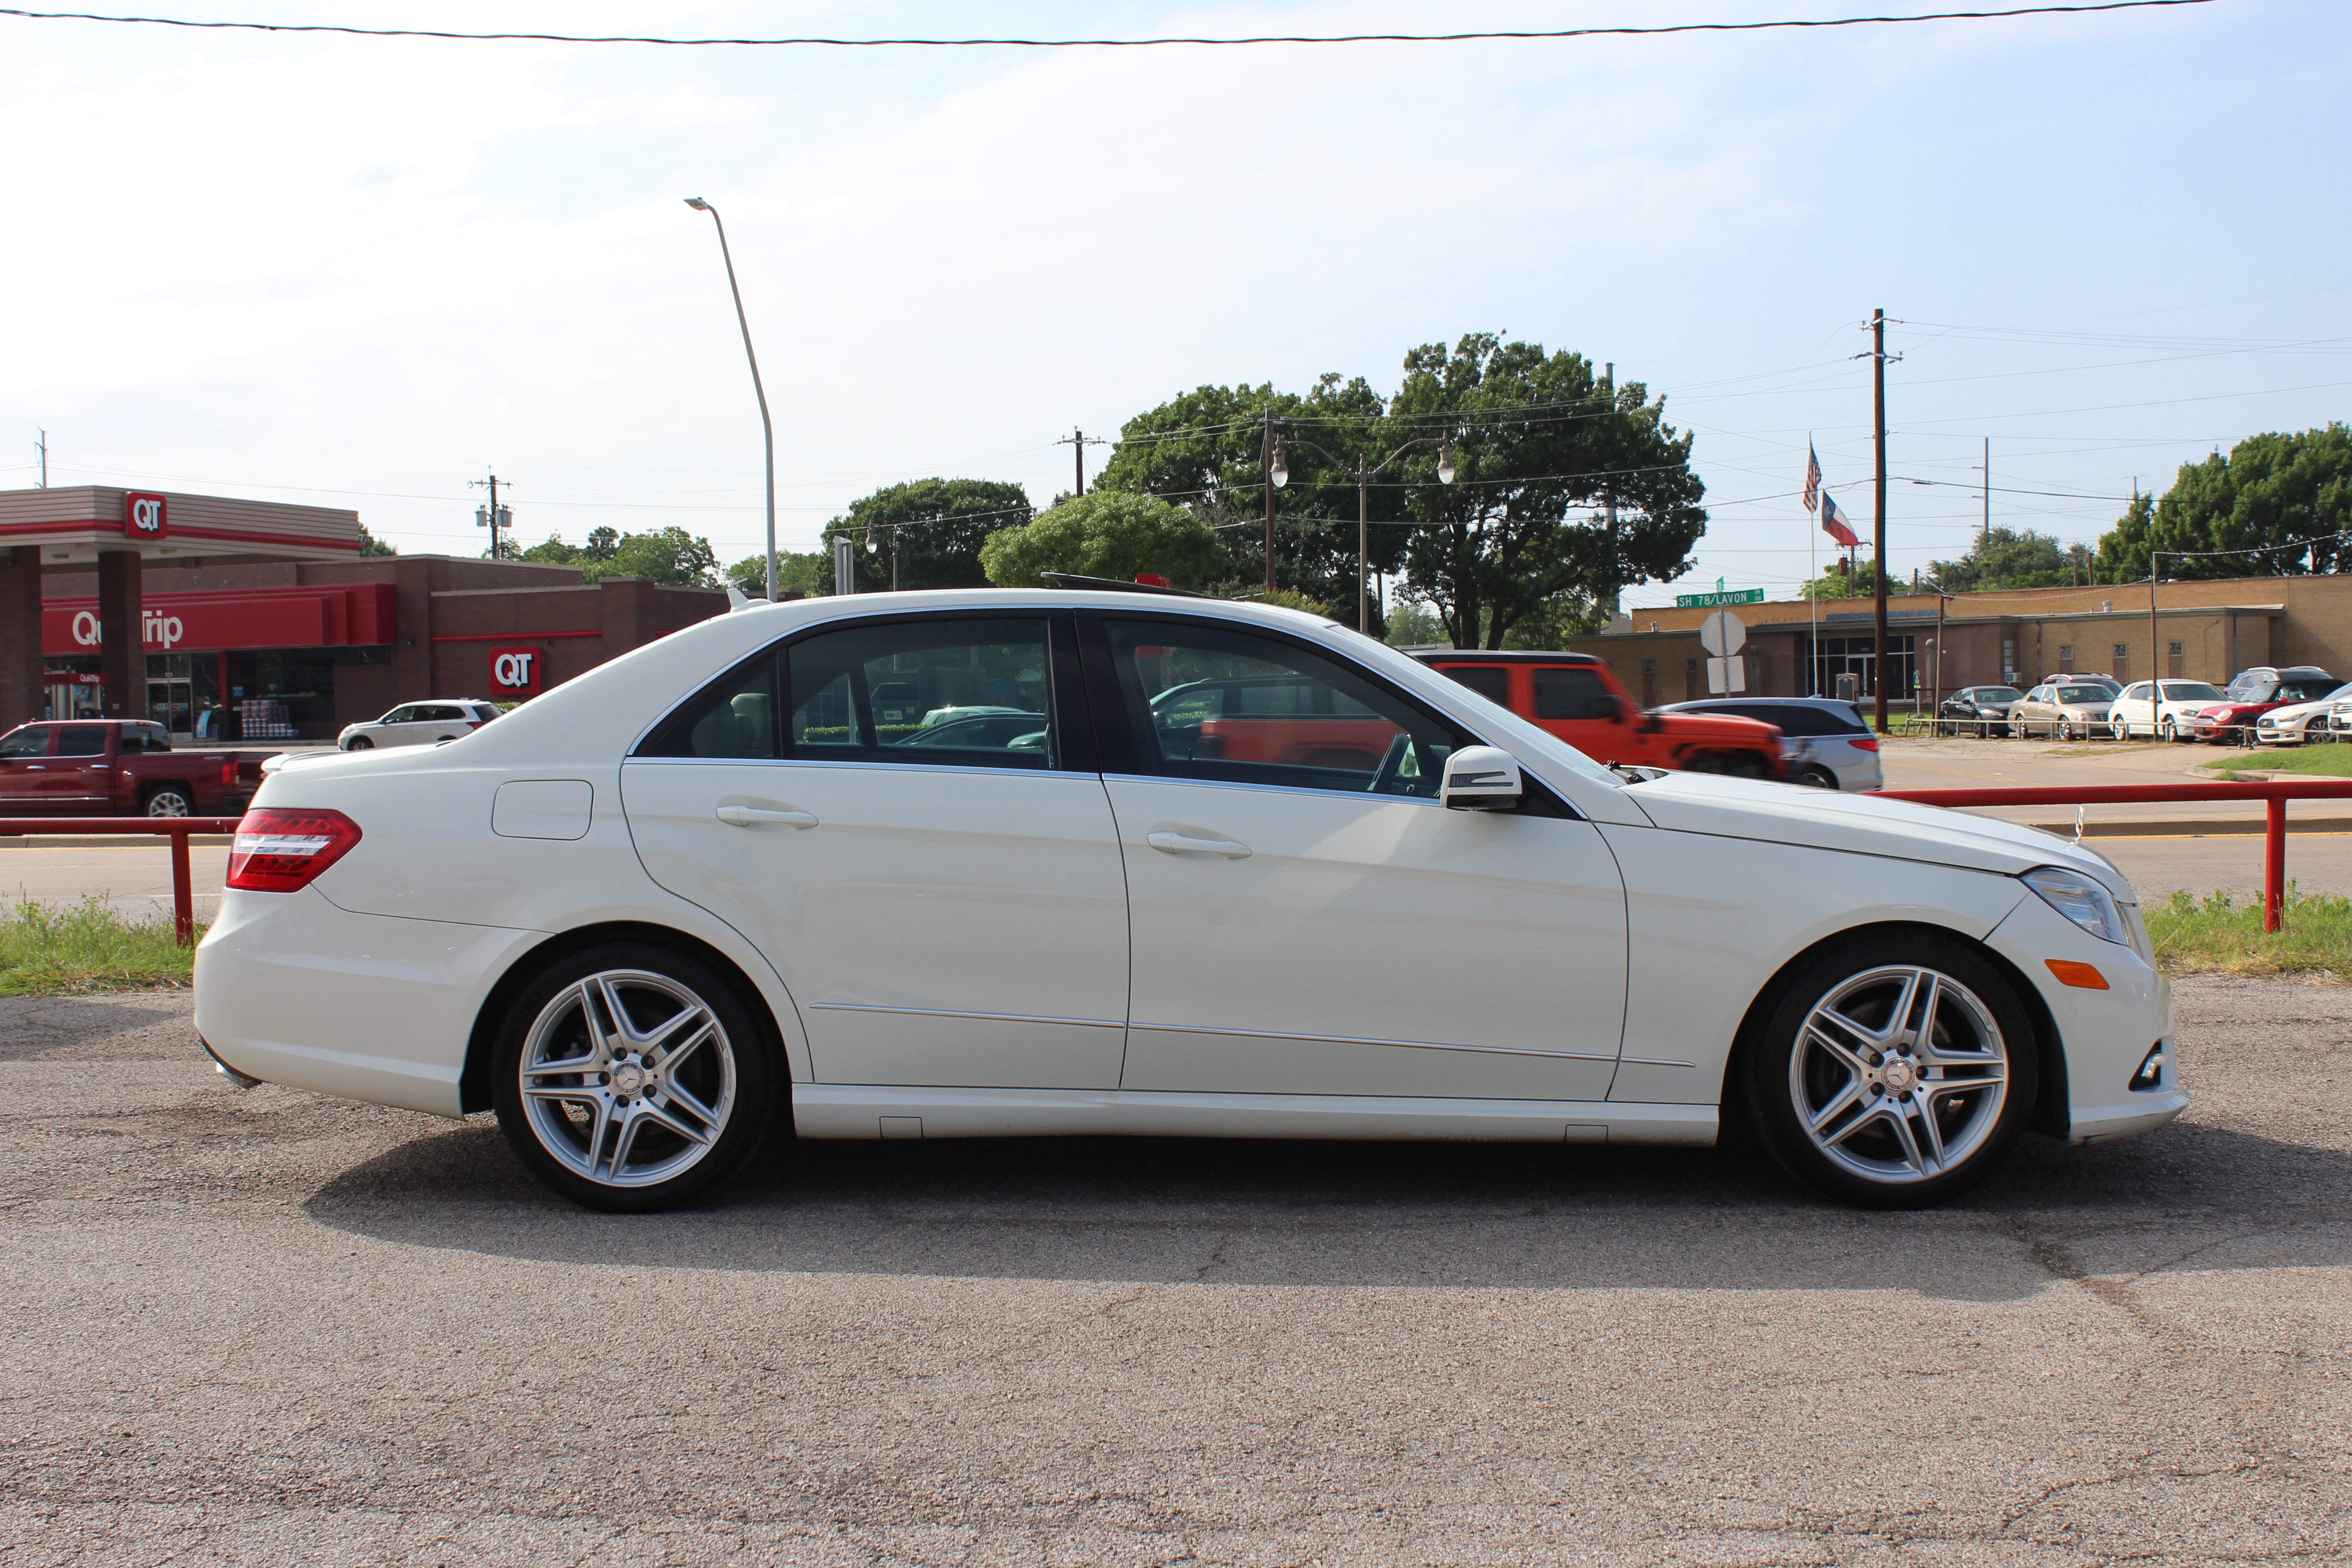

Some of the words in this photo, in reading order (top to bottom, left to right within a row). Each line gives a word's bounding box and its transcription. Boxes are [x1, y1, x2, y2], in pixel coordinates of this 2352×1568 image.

[133, 499, 161, 532] QT
[1679, 597, 1692, 607] SH
[1698, 592, 1747, 606] 78/LAVON
[1758, 617, 1801, 625] GARLAND
[495, 654, 532, 687] QT
